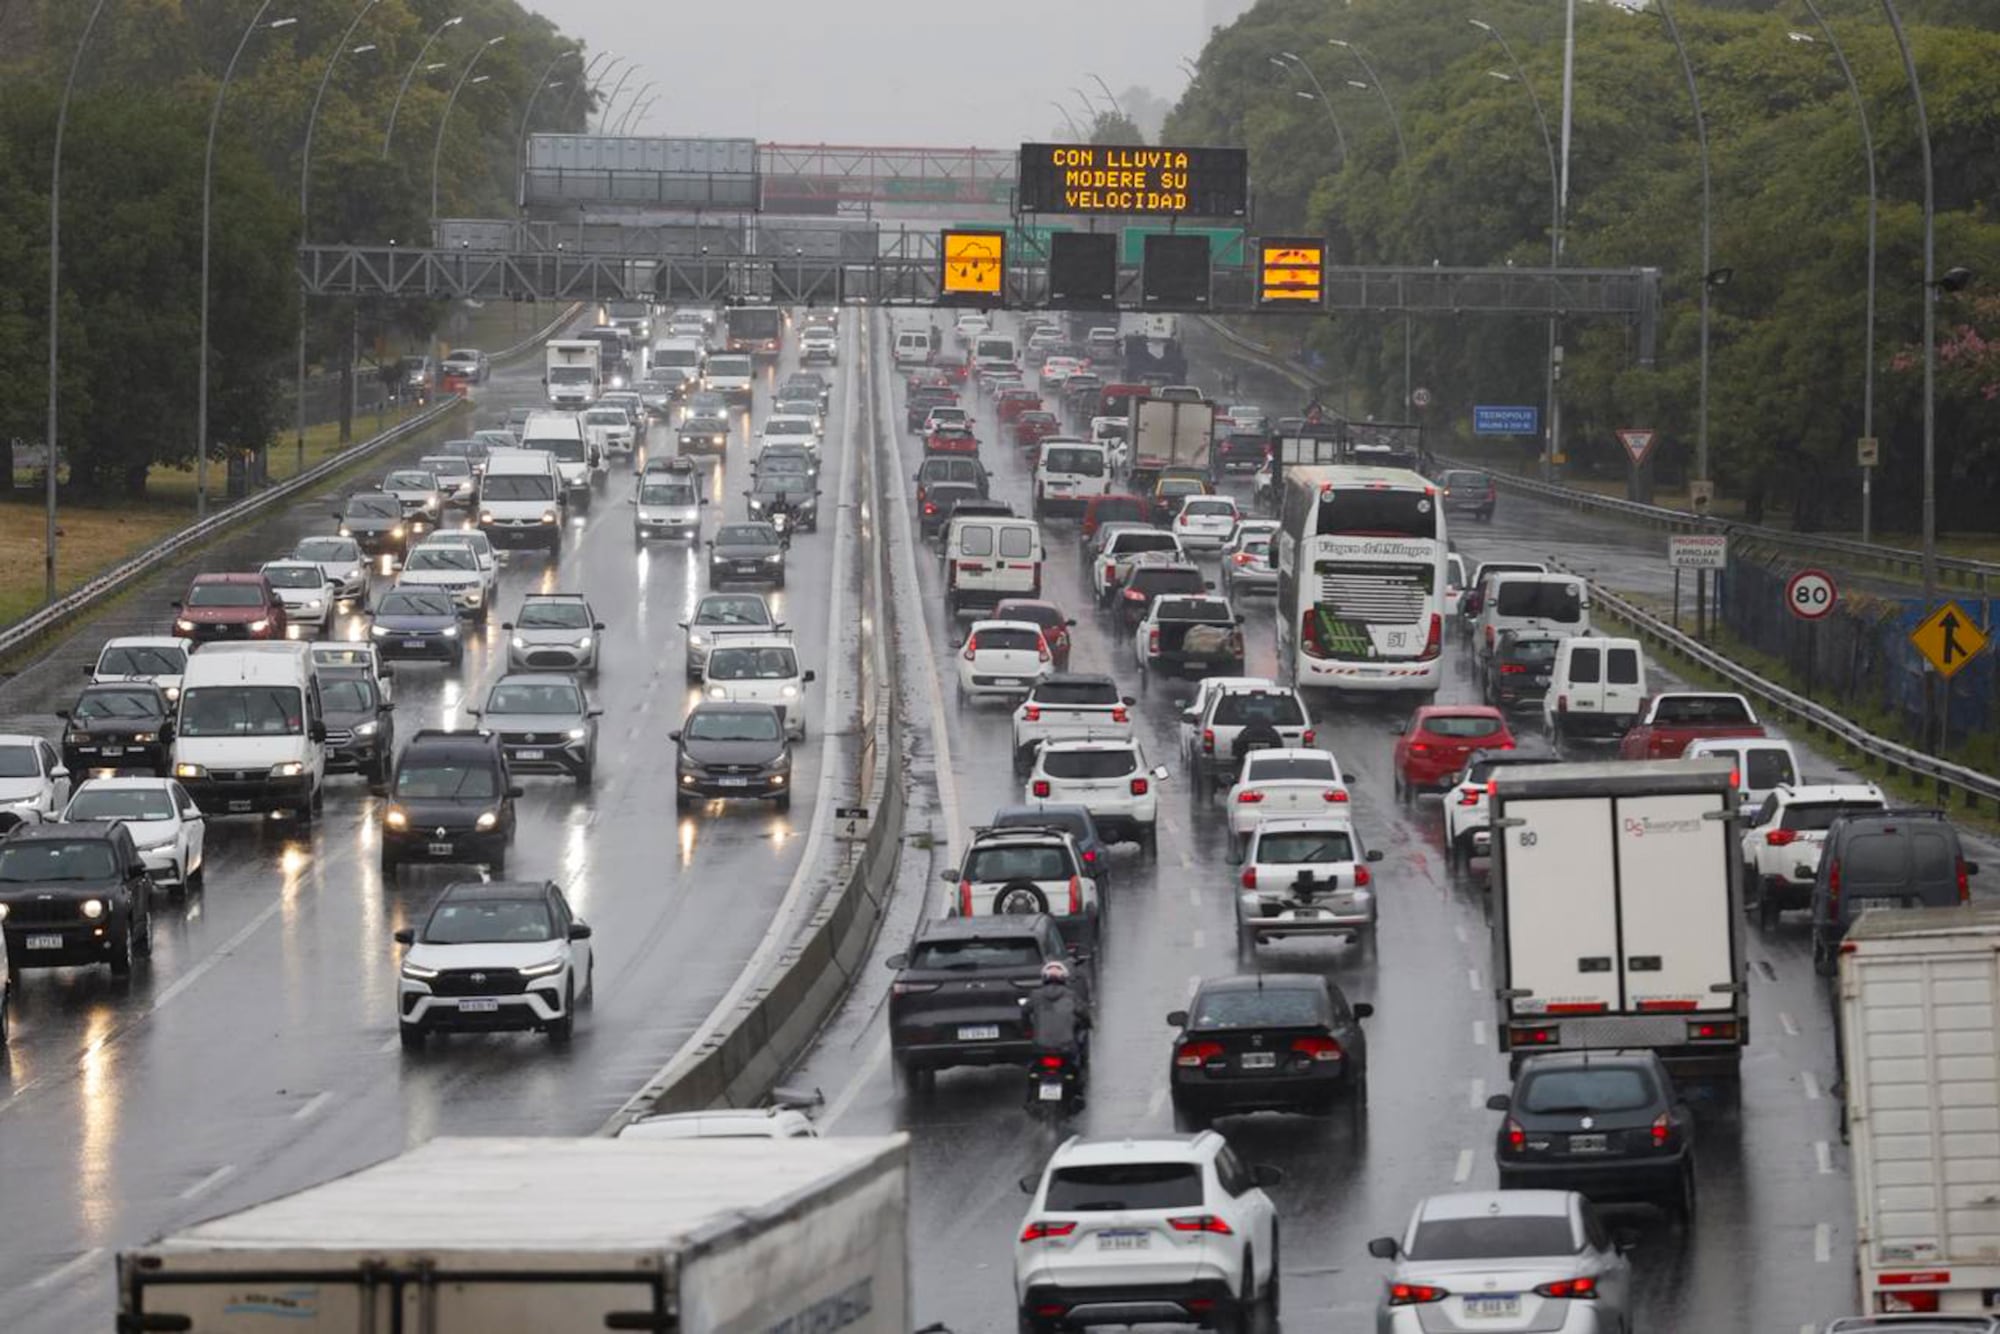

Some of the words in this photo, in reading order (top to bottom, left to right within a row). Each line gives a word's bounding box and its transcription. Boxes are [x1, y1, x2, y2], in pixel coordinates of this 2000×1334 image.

[1053, 149, 1093, 167] CON
[1107, 151, 1188, 169] LLUVIA
[1066, 171, 1146, 188] MODERE
[1160, 173, 1187, 189] SU
[1066, 191, 1187, 210] VELOCIDAD
[1673, 537, 1726, 546] PROHIBIDO
[1675, 549, 1720, 557] ARROJAR
[1678, 557, 1715, 566] BASURA
[1795, 586, 1828, 604] 80
[846, 820, 856, 836] 4
[1519, 832, 1537, 847] 80
